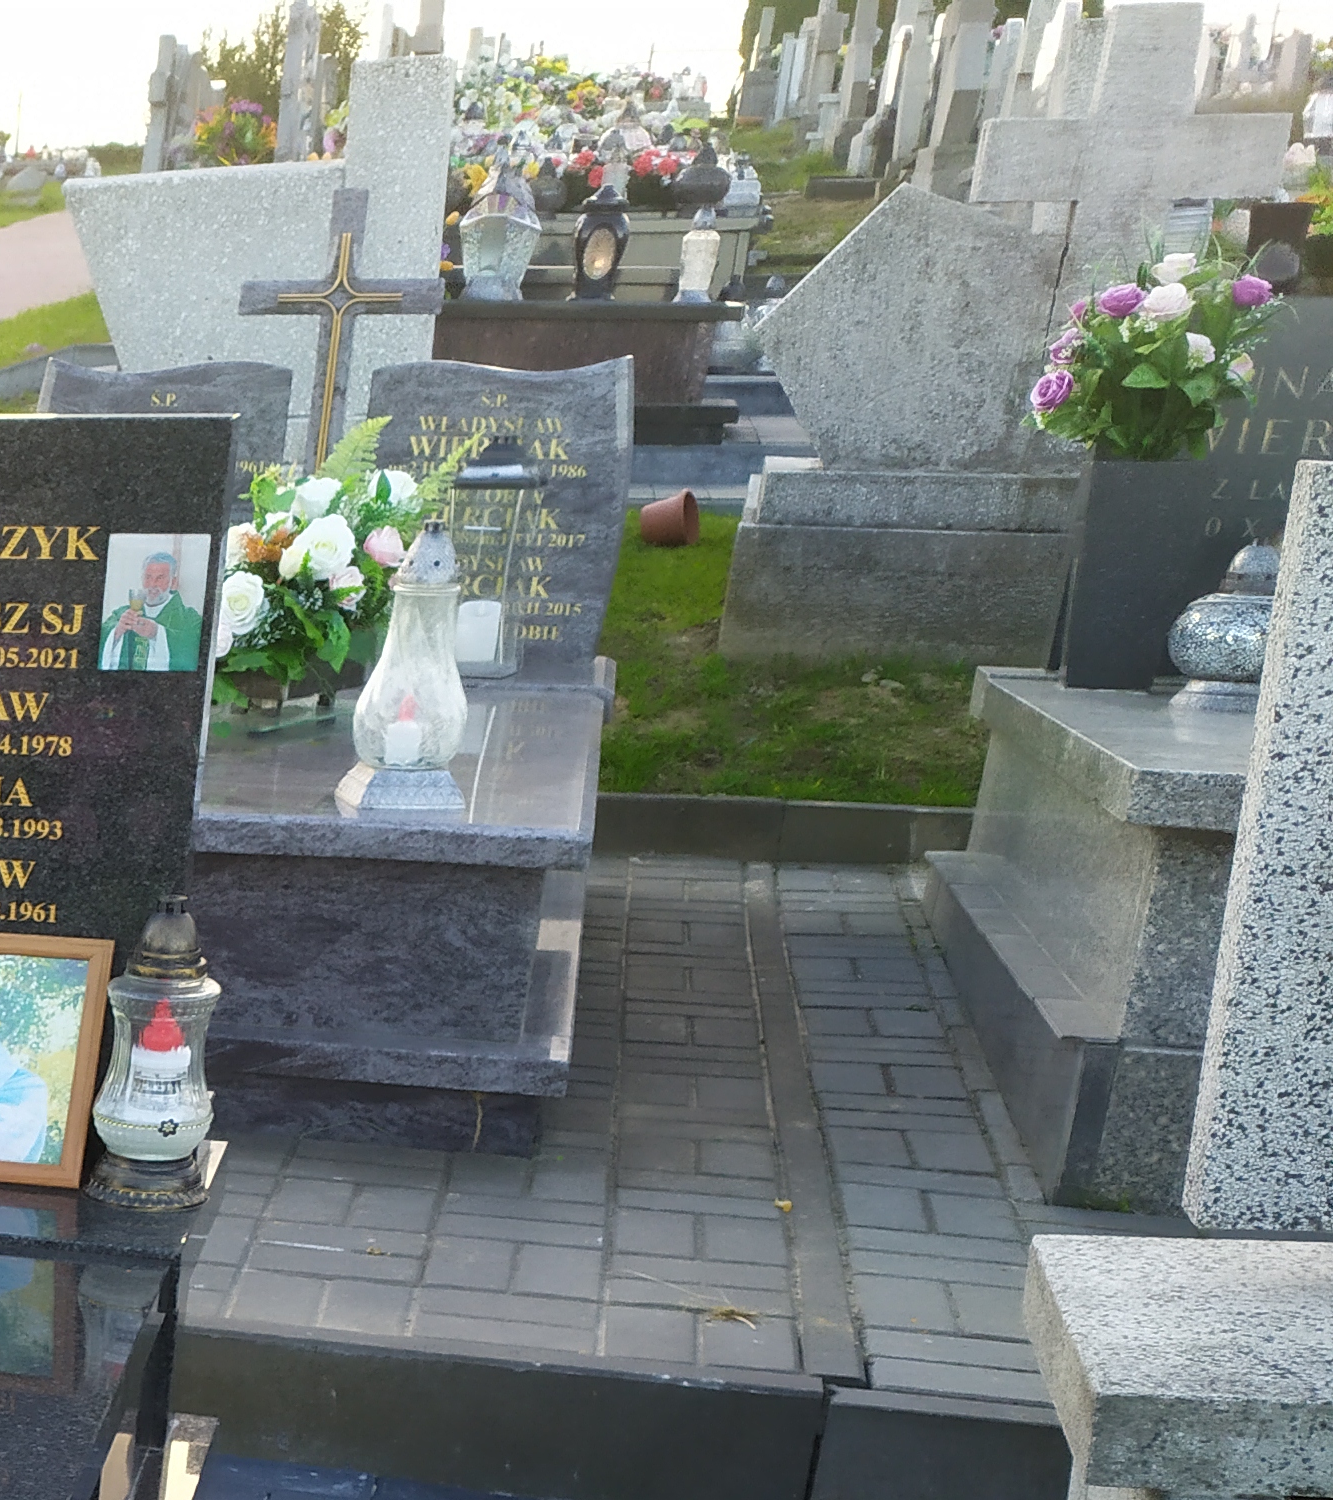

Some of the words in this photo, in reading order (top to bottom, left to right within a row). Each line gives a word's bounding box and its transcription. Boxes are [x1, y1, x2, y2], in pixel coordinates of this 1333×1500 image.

[550, 463, 588, 478] 1986
[547, 533, 586, 548] 2017
[544, 602, 582, 617] 2015
[40, 602, 88, 636] SJ
